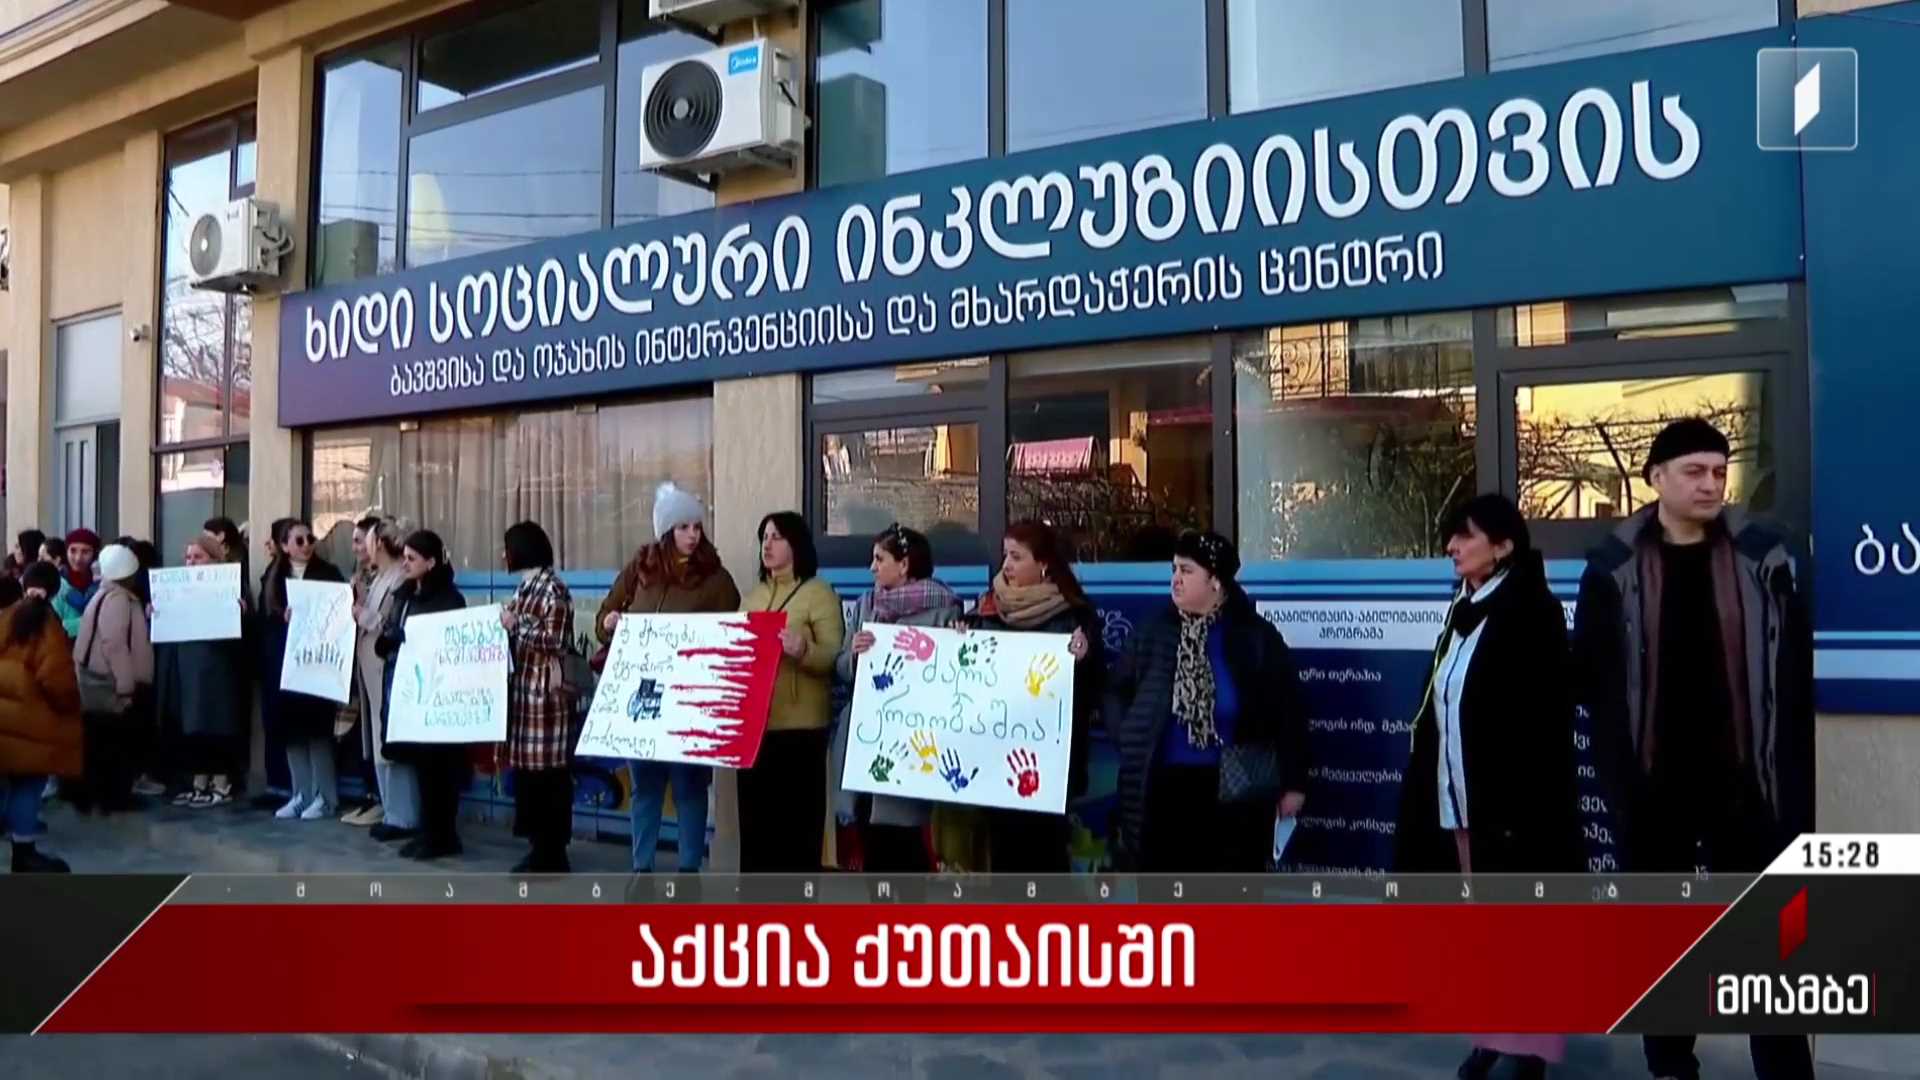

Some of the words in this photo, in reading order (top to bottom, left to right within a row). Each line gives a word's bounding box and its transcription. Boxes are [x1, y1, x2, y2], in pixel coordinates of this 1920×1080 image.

[305, 287, 414, 363] ხიდი
[429, 217, 810, 343] სოციალური
[836, 83, 1700, 283] ინკლუზიისთვის
[390, 353, 484, 396] ბავშვისა
[492, 347, 525, 382] და
[533, 333, 625, 379] ოჯახის
[635, 300, 873, 366] ინტერვენციისა
[887, 292, 936, 335] და
[951, 255, 1242, 329] მხარდაჭერის
[1260, 231, 1443, 295] ცენტრი
[922, 644, 999, 695] ძალა
[1318, 626, 1385, 640] პროგრამა
